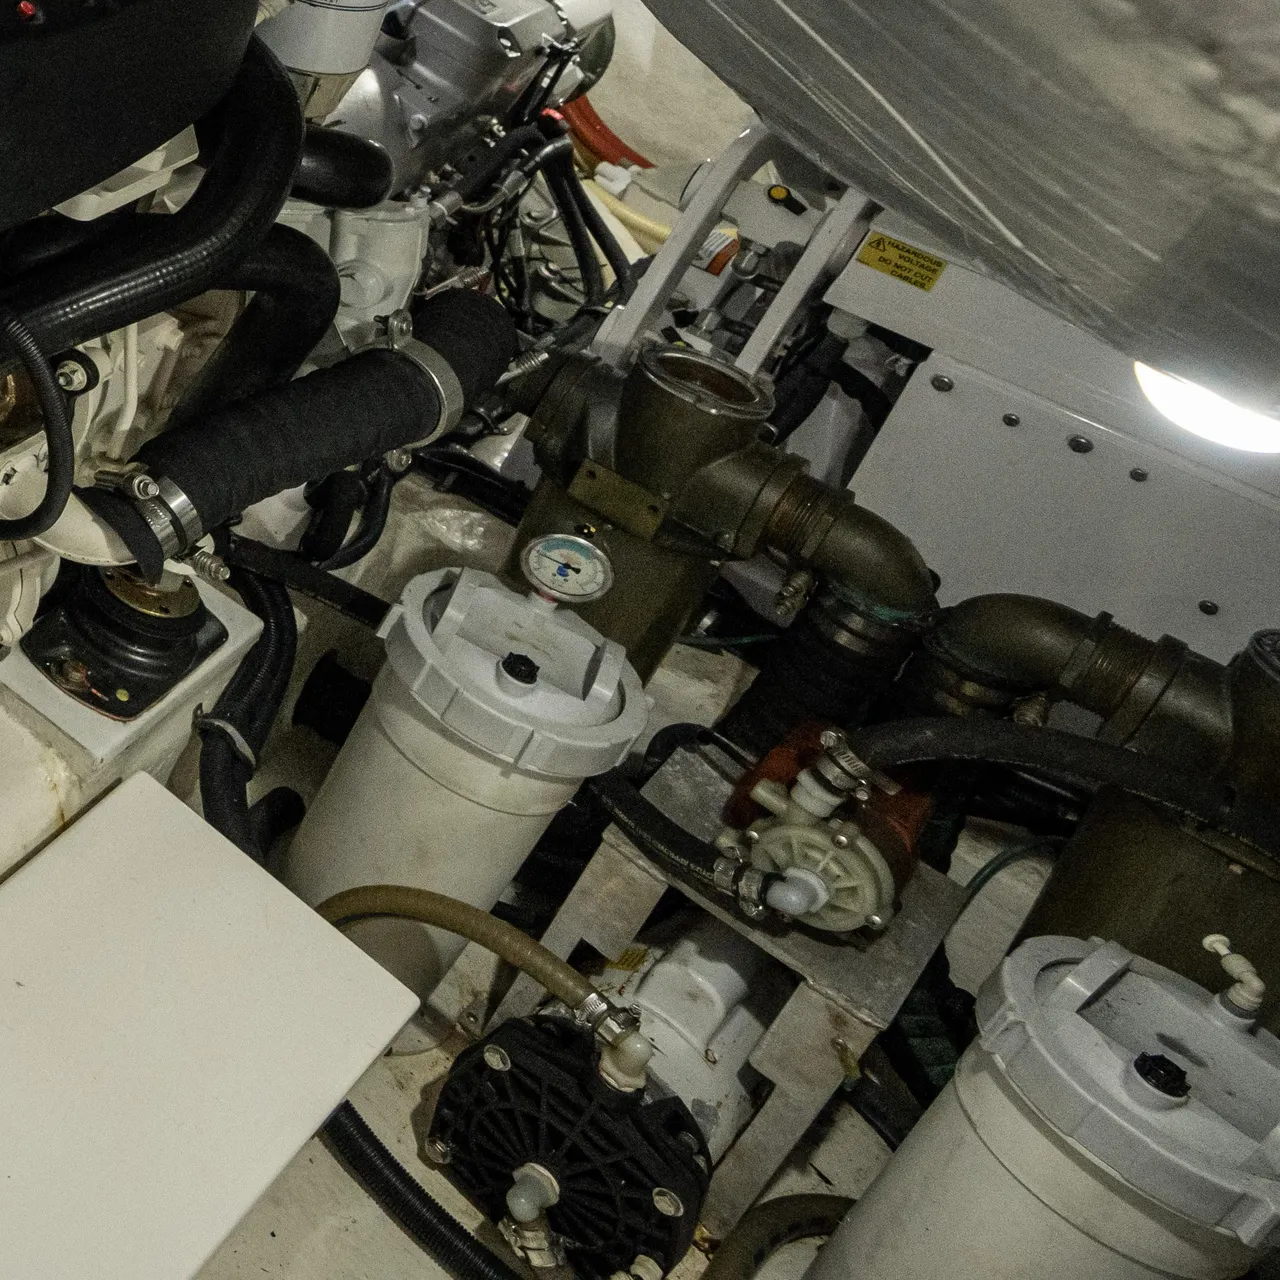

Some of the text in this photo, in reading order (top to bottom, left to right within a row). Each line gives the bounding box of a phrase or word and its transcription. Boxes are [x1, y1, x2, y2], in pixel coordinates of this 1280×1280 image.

[888, 241, 942, 267] HAZARDOUS
[899, 254, 937, 274] VOLTAGE
[878, 256, 933, 282] DO NOT CUT
